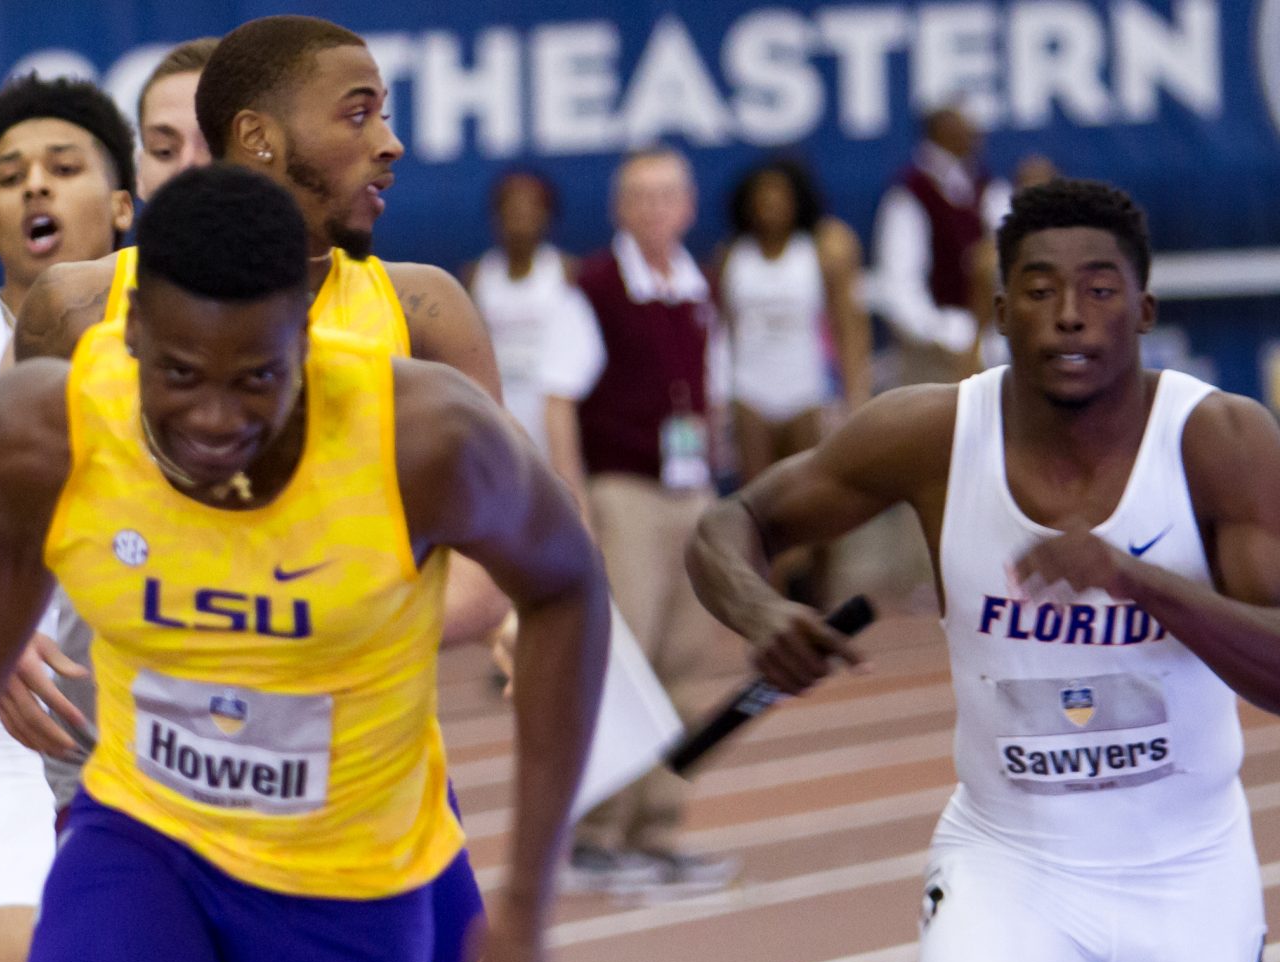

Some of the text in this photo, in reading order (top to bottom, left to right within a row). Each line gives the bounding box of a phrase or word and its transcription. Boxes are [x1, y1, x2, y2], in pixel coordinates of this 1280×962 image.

[142, 577, 313, 640] LSU
[977, 594, 1168, 647] FLORID
[149, 719, 310, 800] Howell
[1003, 736, 1169, 779] Sawyers
